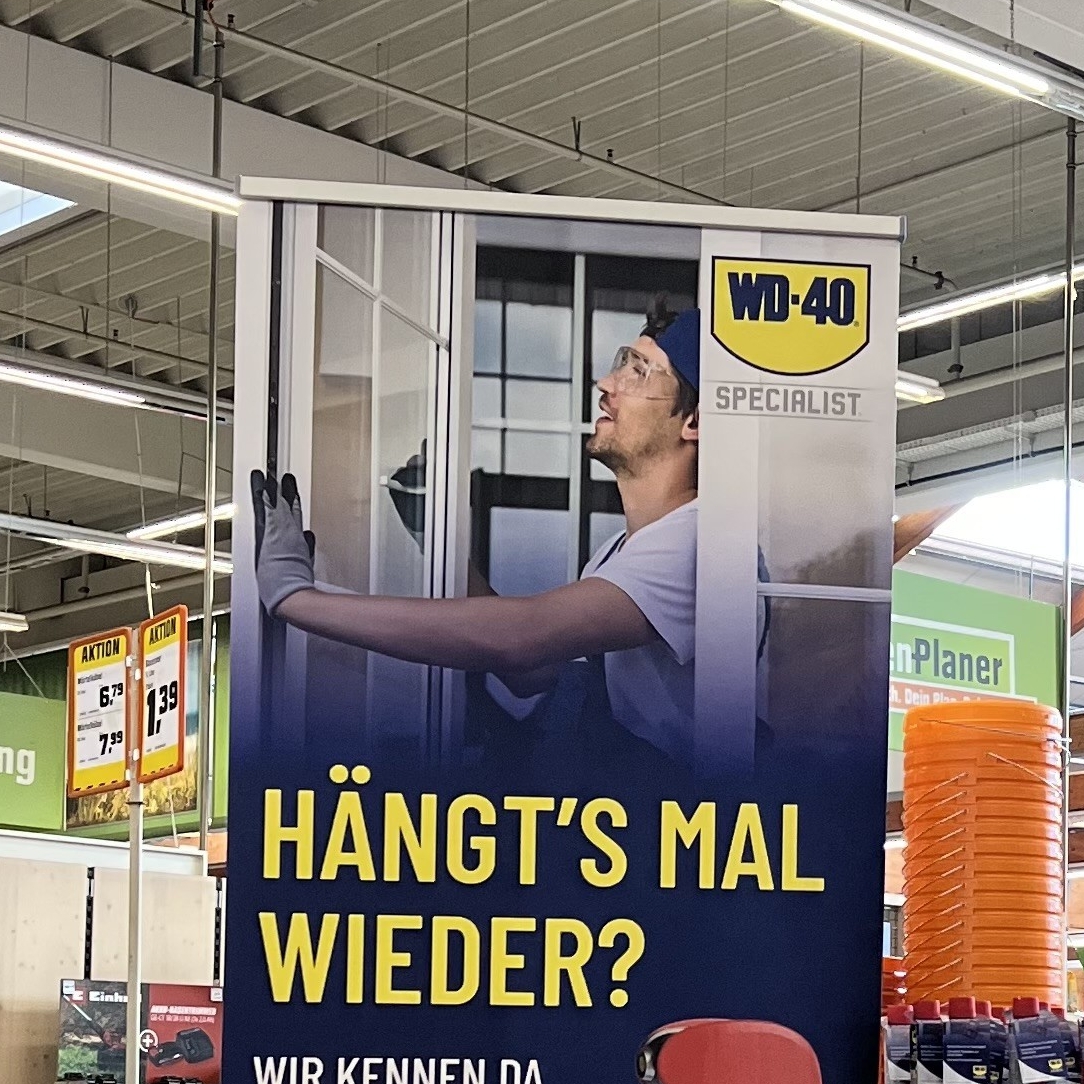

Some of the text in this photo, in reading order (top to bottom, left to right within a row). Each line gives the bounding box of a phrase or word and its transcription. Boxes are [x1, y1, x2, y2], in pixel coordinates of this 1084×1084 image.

[716, 386, 862, 417] SPECIALIST
[149, 616, 177, 645] AKTION
[82, 638, 120, 664] AKTION
[262, 764, 826, 892] HÄNGT'S MAL
[258, 911, 647, 1008] WIEDER?
